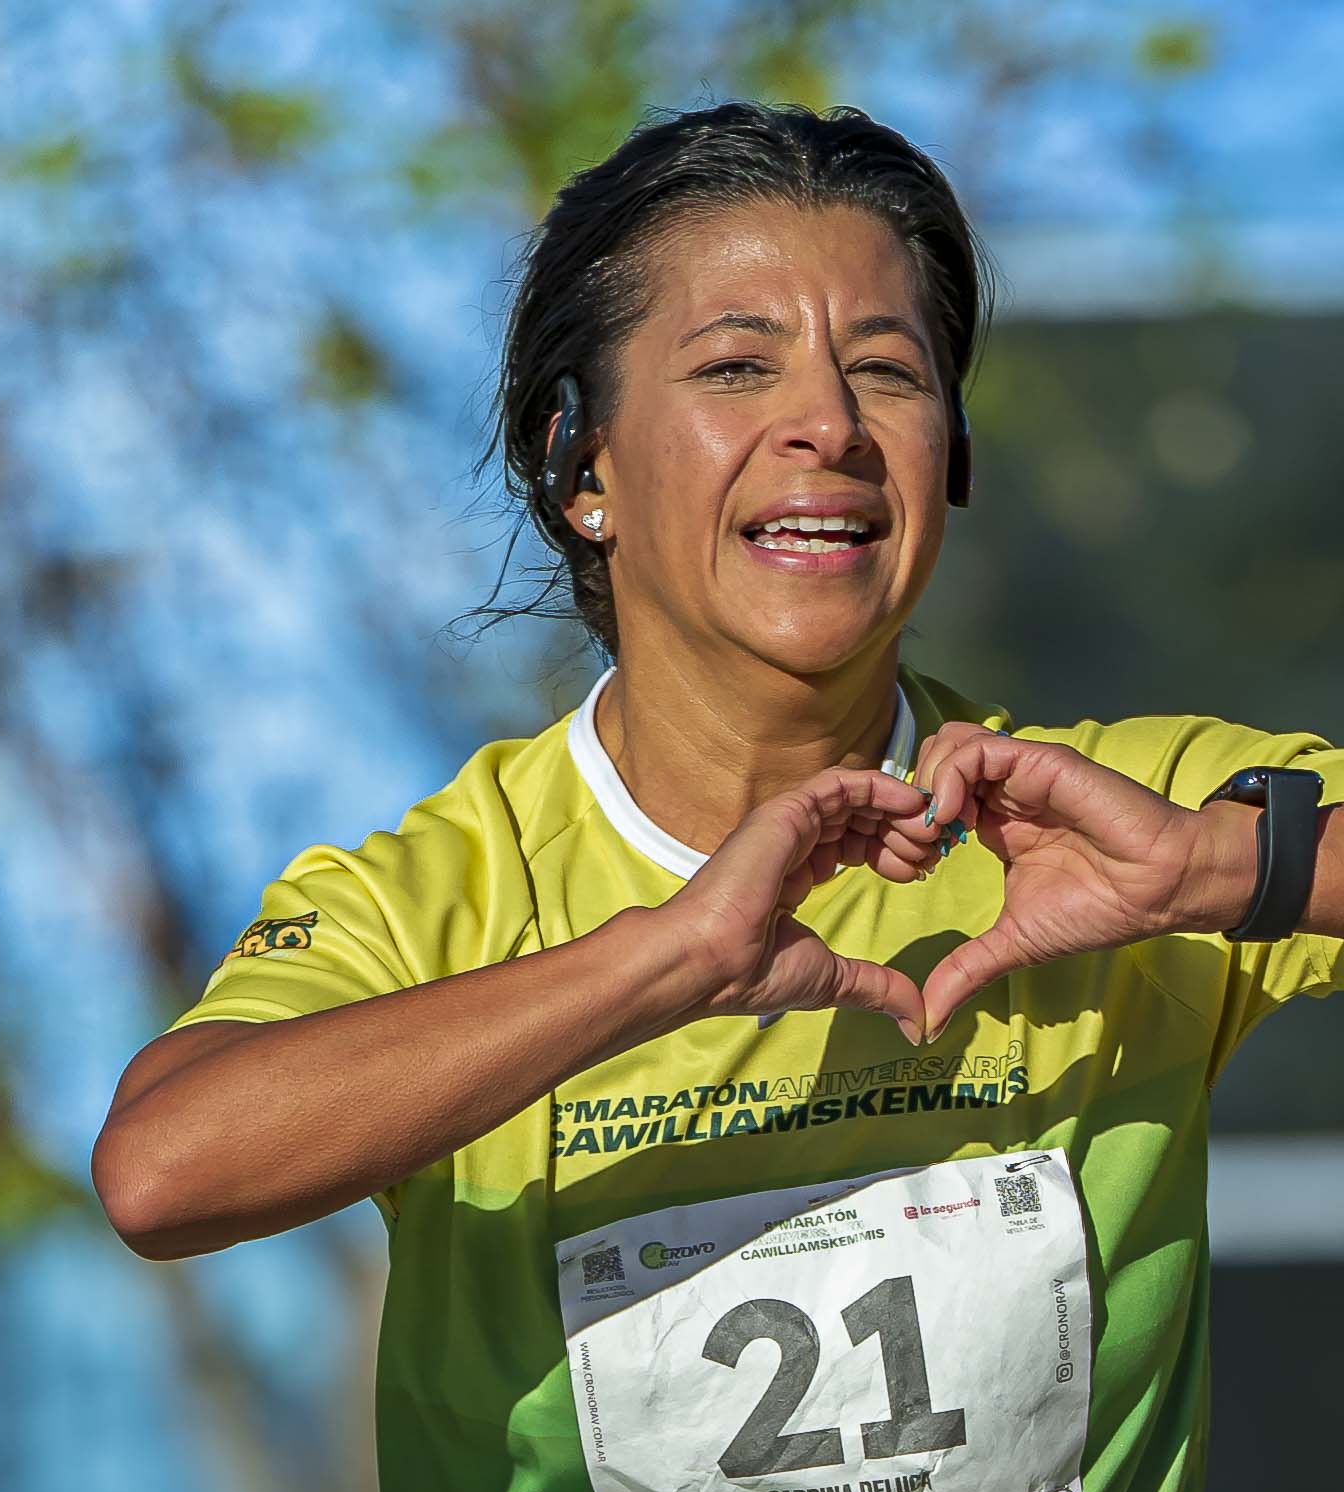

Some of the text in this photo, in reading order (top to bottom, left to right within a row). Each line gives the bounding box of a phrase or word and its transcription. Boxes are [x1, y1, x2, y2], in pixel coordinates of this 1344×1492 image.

[920, 1197, 981, 1216] la segunda
[740, 1228, 885, 1261] CAWILLIAMSKEMMIS
[1053, 1278, 1071, 1361] @CRONORAV
[701, 1275, 967, 1478] 21
